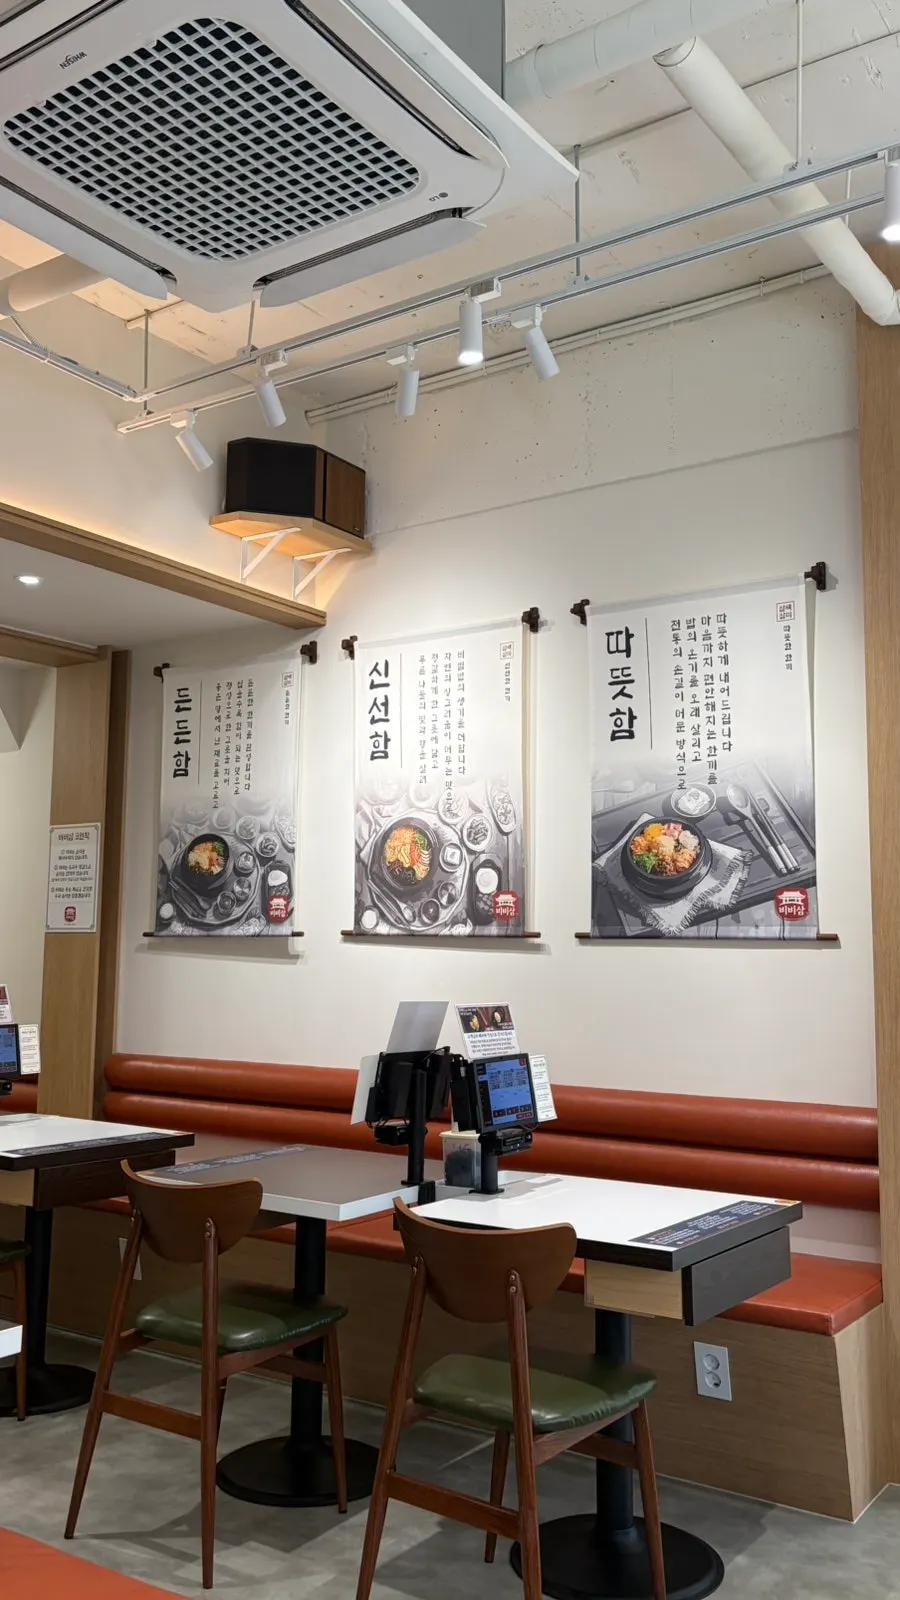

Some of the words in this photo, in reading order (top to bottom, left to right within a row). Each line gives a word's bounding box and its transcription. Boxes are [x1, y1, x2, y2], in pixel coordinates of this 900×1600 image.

[60, 51, 87, 69] WHISEN
[671, 619, 683, 658] 전통의
[686, 617, 697, 642] 밥의
[701, 615, 714, 668] 마음까지
[716, 612, 729, 666] 따뜻하게
[457, 650, 465, 692] 비빔밥의
[605, 626, 638, 742] 따뜻함
[673, 664, 684, 702] 손길이
[688, 648, 699, 688] 온기를
[368, 659, 391, 761] 신선함
[675, 707, 686, 733] 머문
[690, 693, 701, 718] 오래
[703, 673, 717, 740] 편안해지는
[173, 687, 192, 778] 든든함
[691, 723, 702, 762] 살리고
[458, 732, 466, 776] 더합니다
[676, 738, 687, 790] 방식으로
[270, 909, 286, 918] 비비삼
[496, 906, 516, 916] 비비삼
[778, 905, 804, 916] 비비삼
